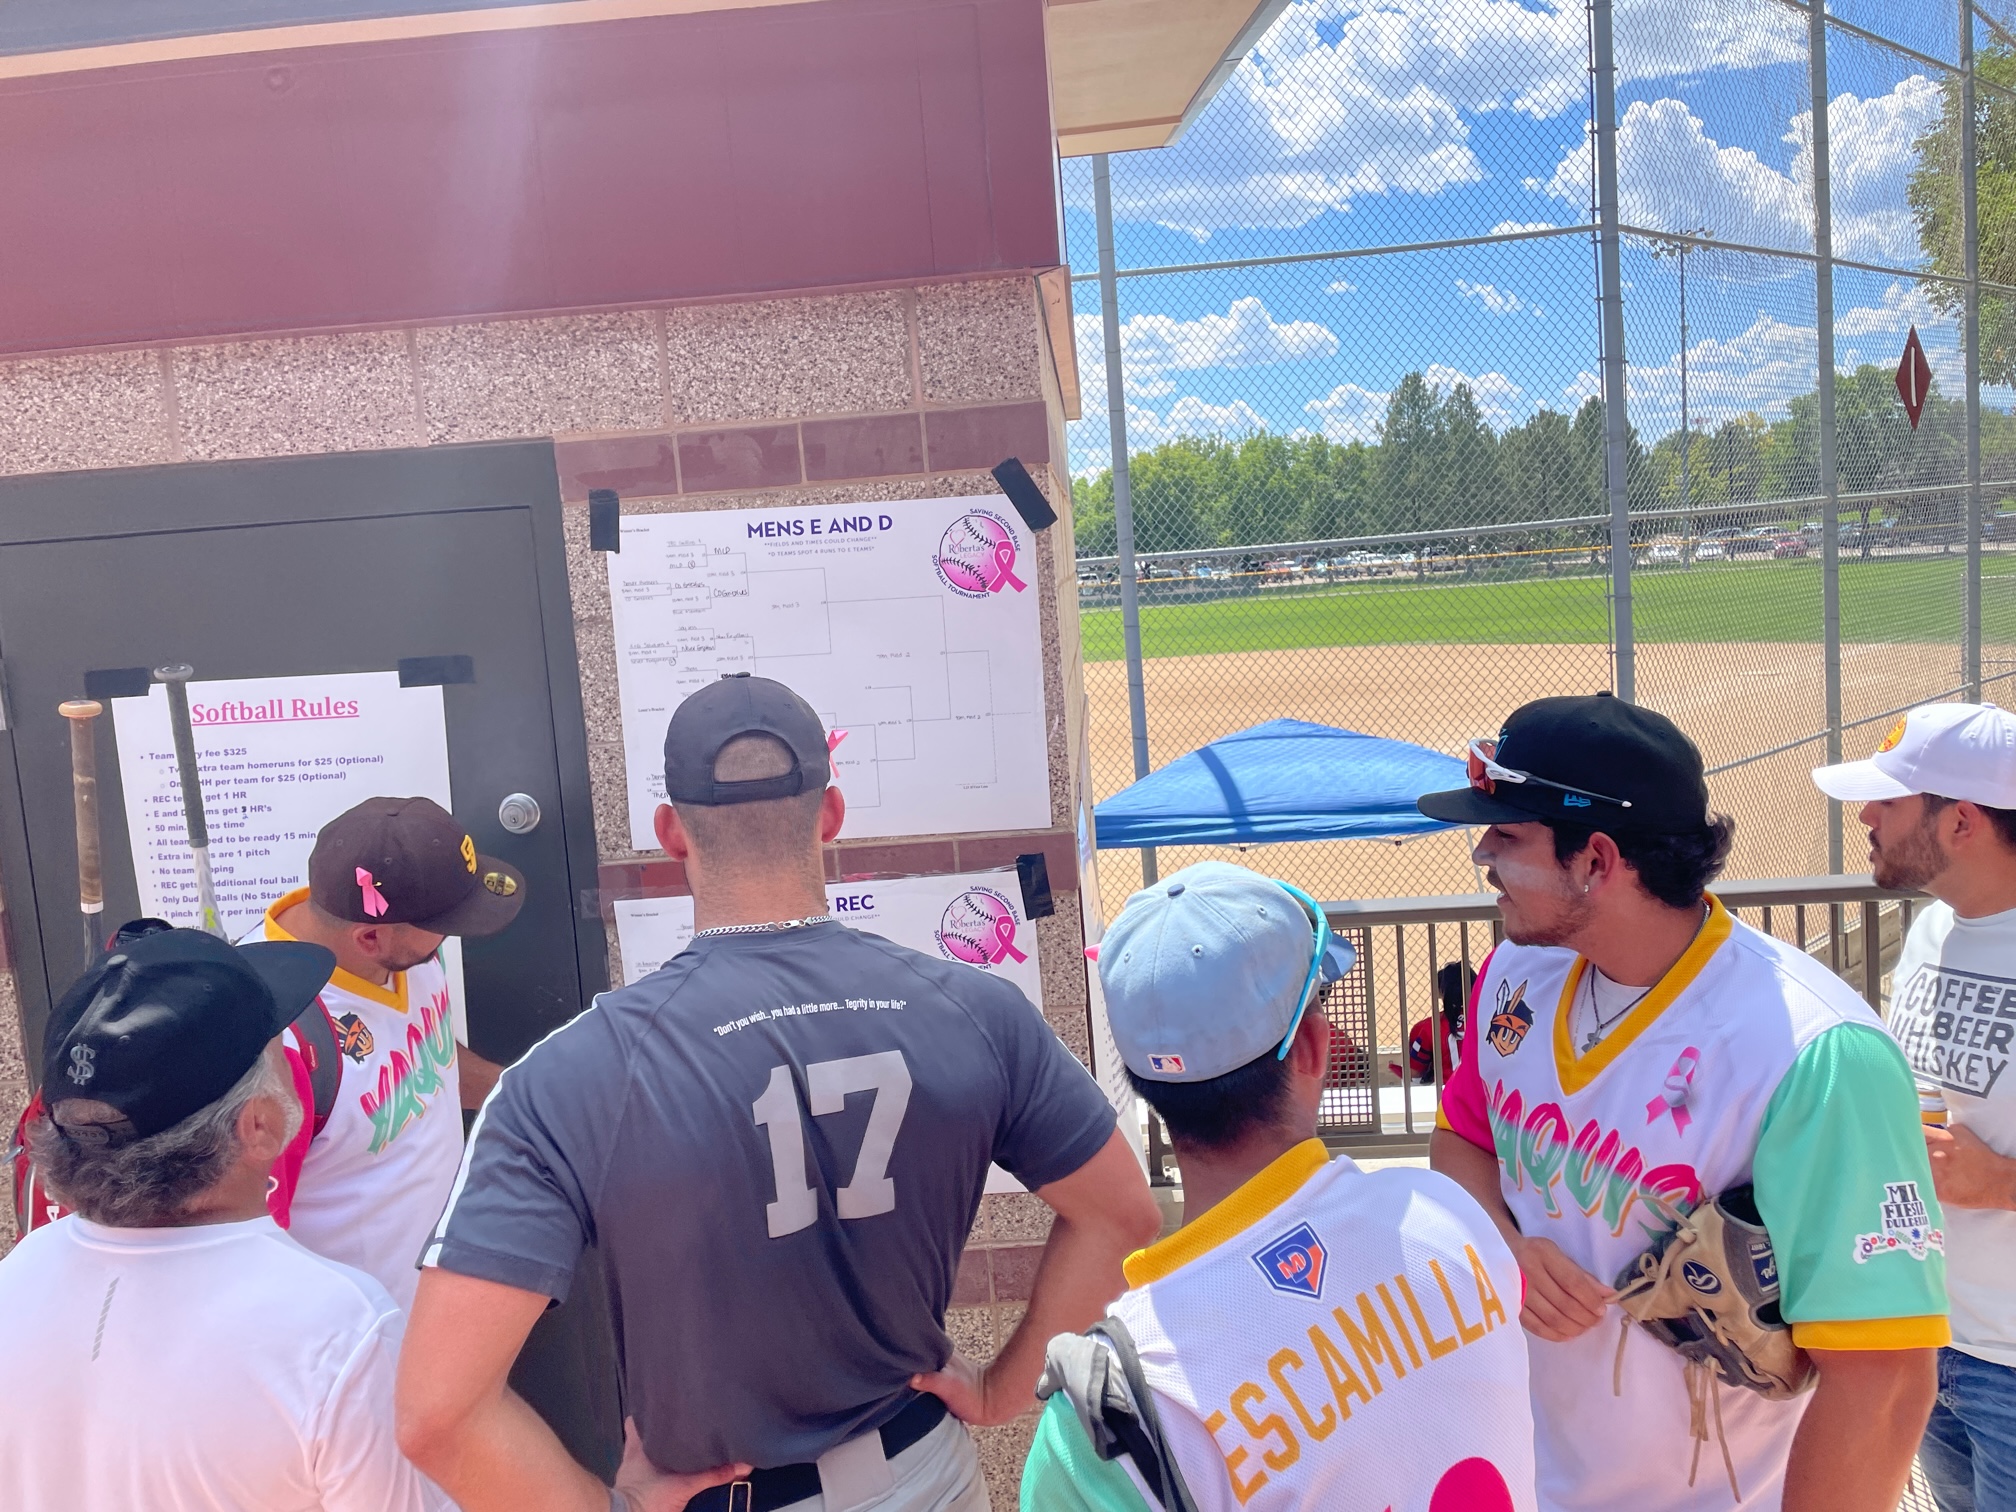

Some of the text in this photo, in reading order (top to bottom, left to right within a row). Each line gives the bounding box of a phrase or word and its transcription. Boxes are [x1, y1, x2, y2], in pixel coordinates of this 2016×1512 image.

[748, 515, 893, 539] MENS E AND D
[970, 508, 1021, 552] SAVING SECOND BASE
[948, 544, 984, 554] Roberta's
[932, 554, 947, 586] SOFTBALL
[948, 584, 990, 600] TOURNAMENT
[192, 696, 359, 723] Softball Rules
[149, 748, 247, 760] Team fee $325
[220, 763, 245, 771] team
[248, 761, 295, 770] homeruns
[314, 758, 332, 766] $25
[335, 755, 384, 766] (Optional)
[216, 778, 231, 787] per
[278, 774, 295, 782] $25
[298, 772, 346, 783] (Optional)
[205, 793, 220, 802] get
[222, 807, 238, 816] get
[250, 804, 272, 812] HR's
[254, 833, 280, 842] ready
[284, 832, 296, 840] 15
[158, 853, 180, 861] Extra
[246, 849, 270, 859] pitch
[180, 882, 197, 890] gets
[281, 876, 299, 884] ball
[162, 896, 179, 904] Only
[215, 894, 238, 902] Balls
[241, 893, 258, 902] (No
[836, 894, 875, 912] REC
[970, 886, 1020, 926] SAVING SECOND BASE
[171, 909, 195, 918] pinch
[228, 909, 242, 917] per
[950, 920, 985, 929] Roberta's
[934, 930, 950, 959] SOFTBALL
[1905, 972, 2016, 1020] COFFEE
[736, 1017, 750, 1030] you
[770, 1007, 783, 1020] you
[783, 1005, 796, 1016] had
[801, 1003, 818, 1015] little
[845, 998, 868, 1011] Tegrity
[869, 998, 875, 1008] in
[876, 1000, 890, 1011] your
[1931, 1011, 2015, 1055] BEER
[359, 981, 456, 1155] YAQU
[752, 1049, 913, 1239] 17
[1886, 1184, 1918, 1204] MI
[1884, 1201, 1926, 1218] FIESTA
[1204, 1244, 1507, 1507] ESCAMILLA
